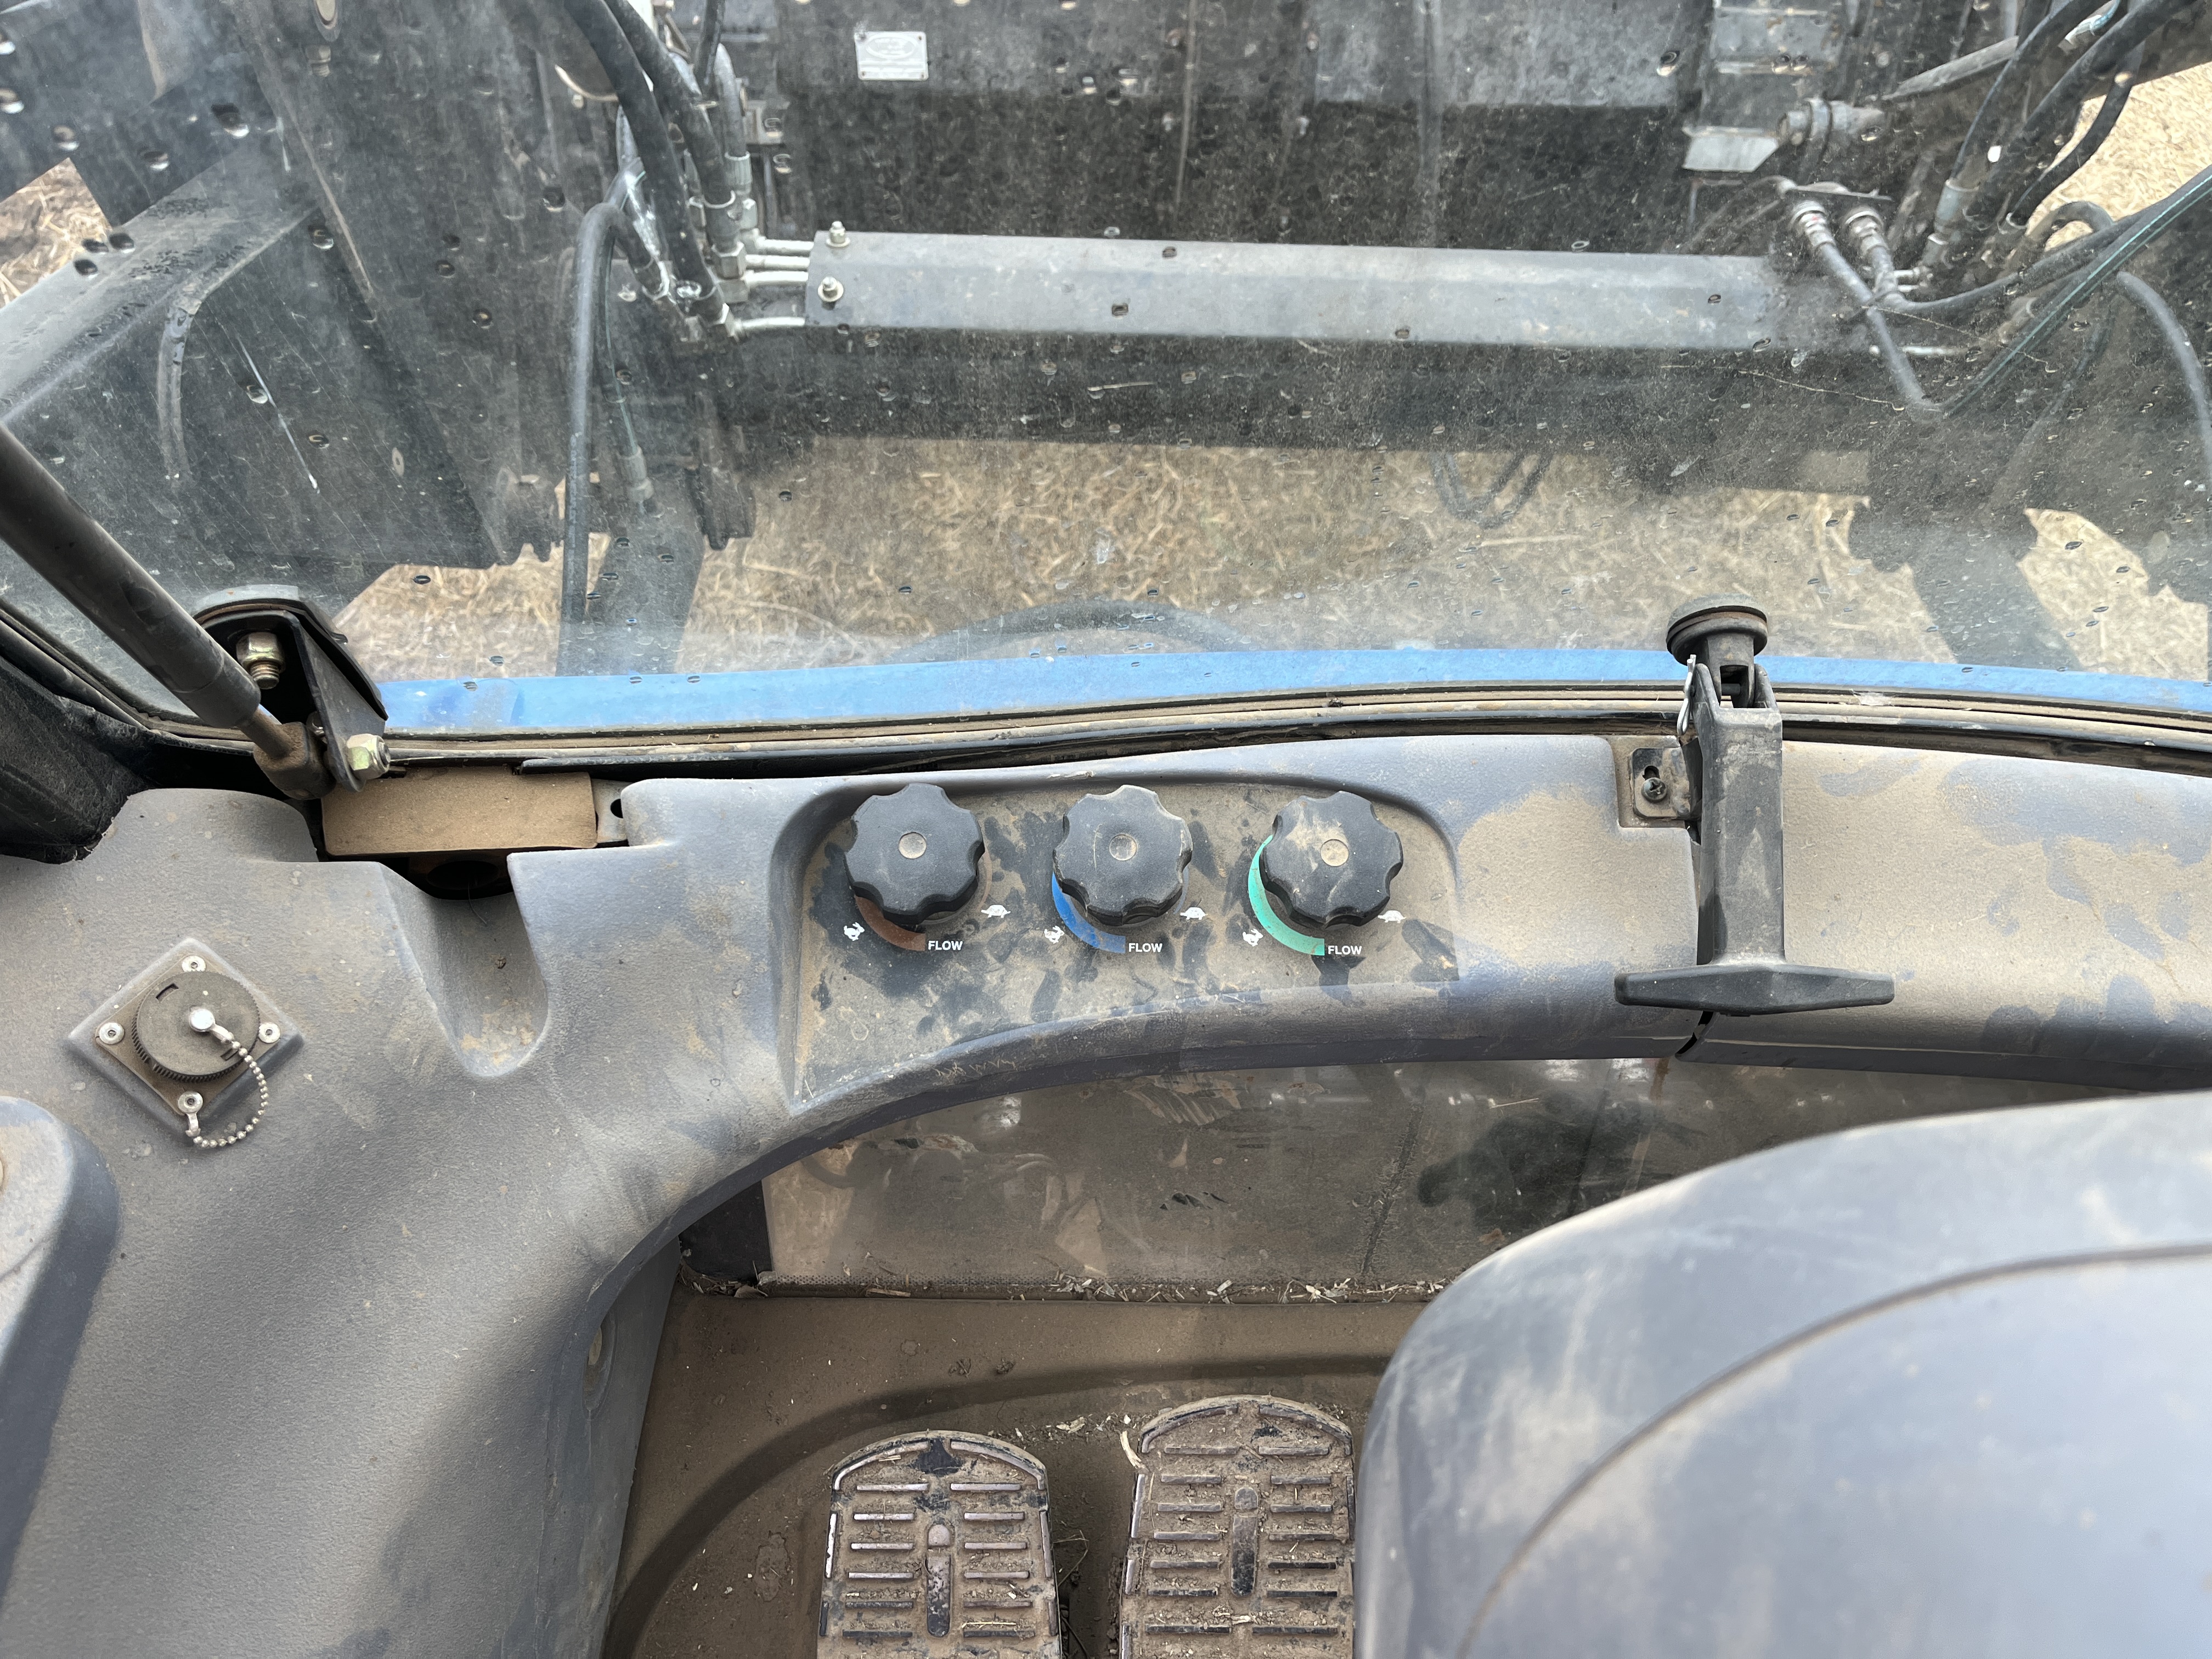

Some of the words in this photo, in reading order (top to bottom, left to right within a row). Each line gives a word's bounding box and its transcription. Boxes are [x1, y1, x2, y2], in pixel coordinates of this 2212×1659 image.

[928, 940, 963, 951] FLOW
[1128, 943, 1163, 953] FLOW
[1328, 945, 1362, 955] FLOW
